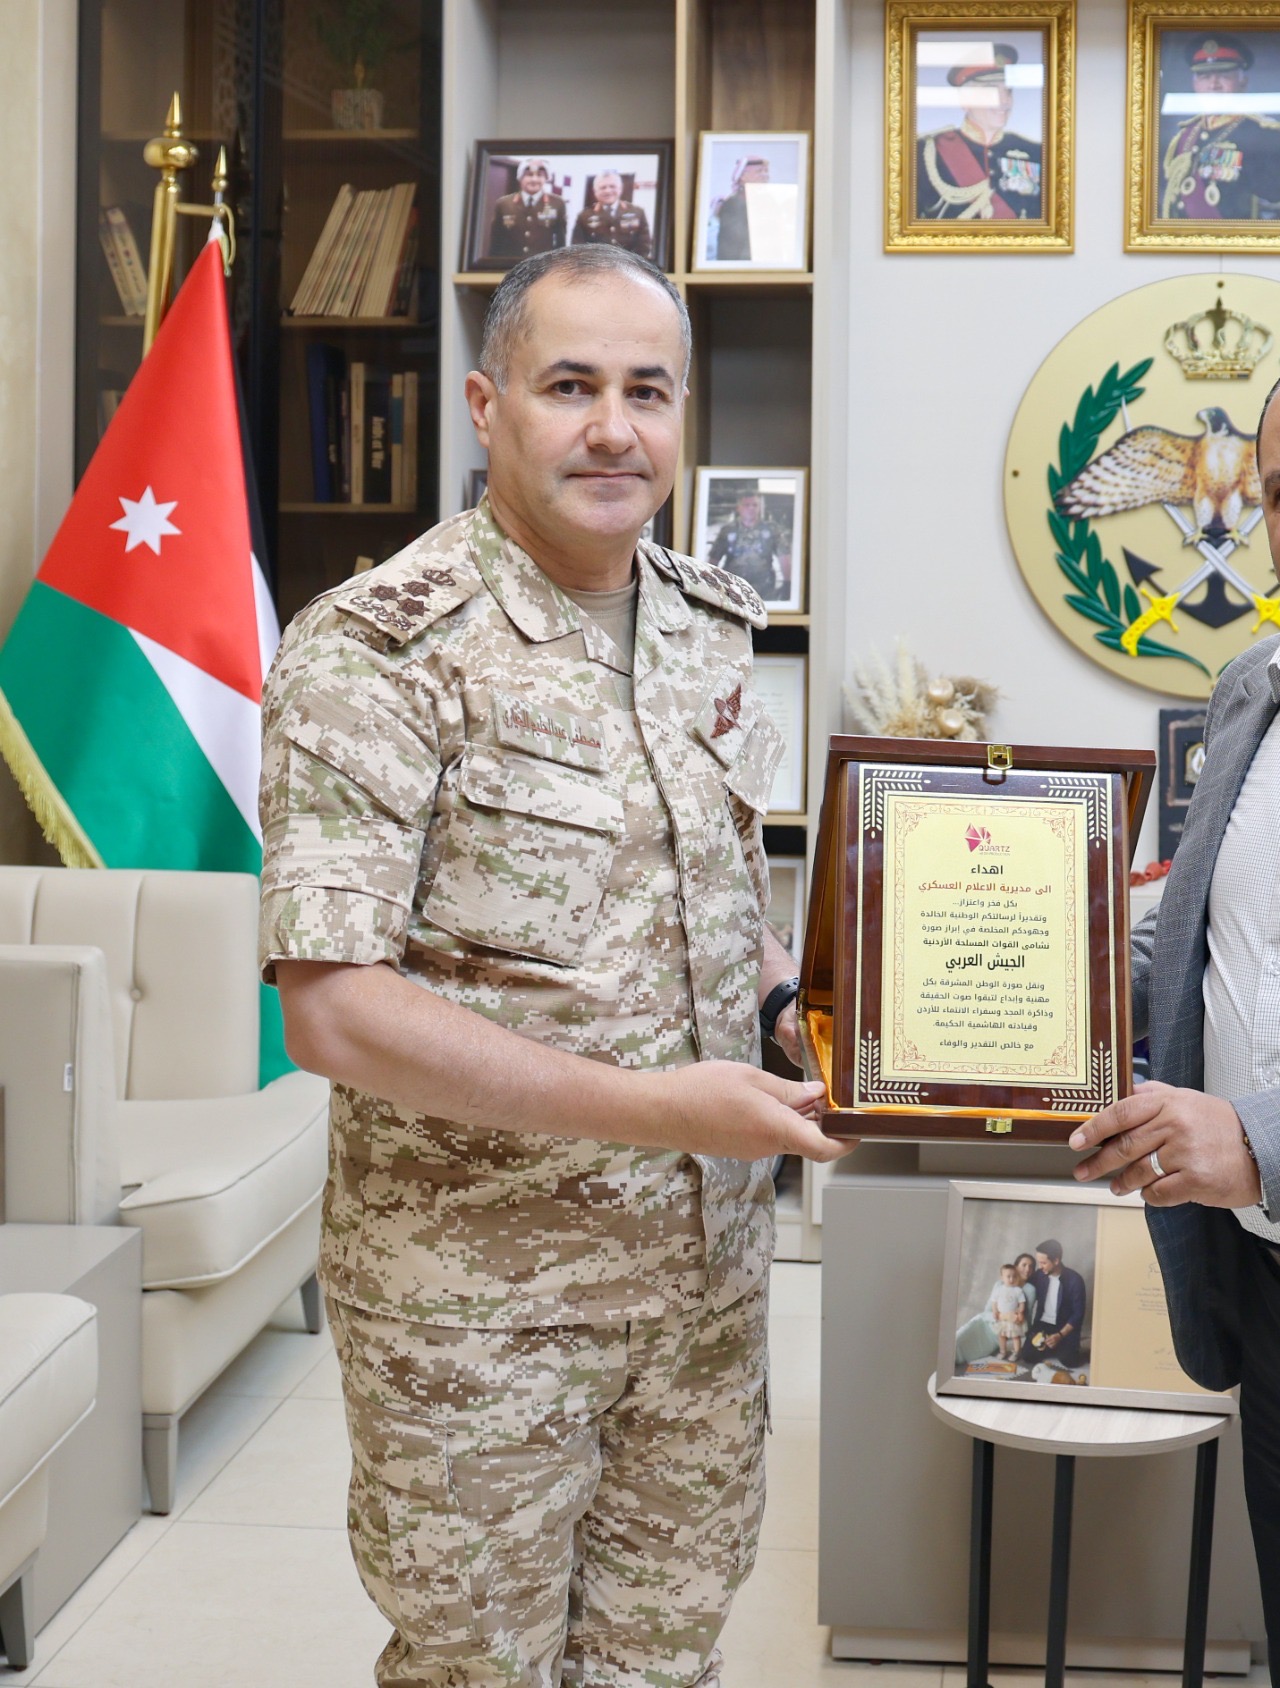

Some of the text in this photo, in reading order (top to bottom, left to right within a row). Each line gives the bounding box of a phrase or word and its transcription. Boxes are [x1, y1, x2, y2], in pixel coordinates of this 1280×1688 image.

[978, 844, 1010, 853] QUARTZ
[970, 864, 1004, 875] اهداء
[918, 880, 962, 892] العسكري
[1000, 883, 1032, 894] مديرية
[1034, 885, 1052, 895] الى
[955, 938, 989, 948] المسلحة
[992, 940, 1019, 950] القوات
[1022, 941, 1050, 950] نشامى
[945, 952, 1025, 974] الجيش العربي
